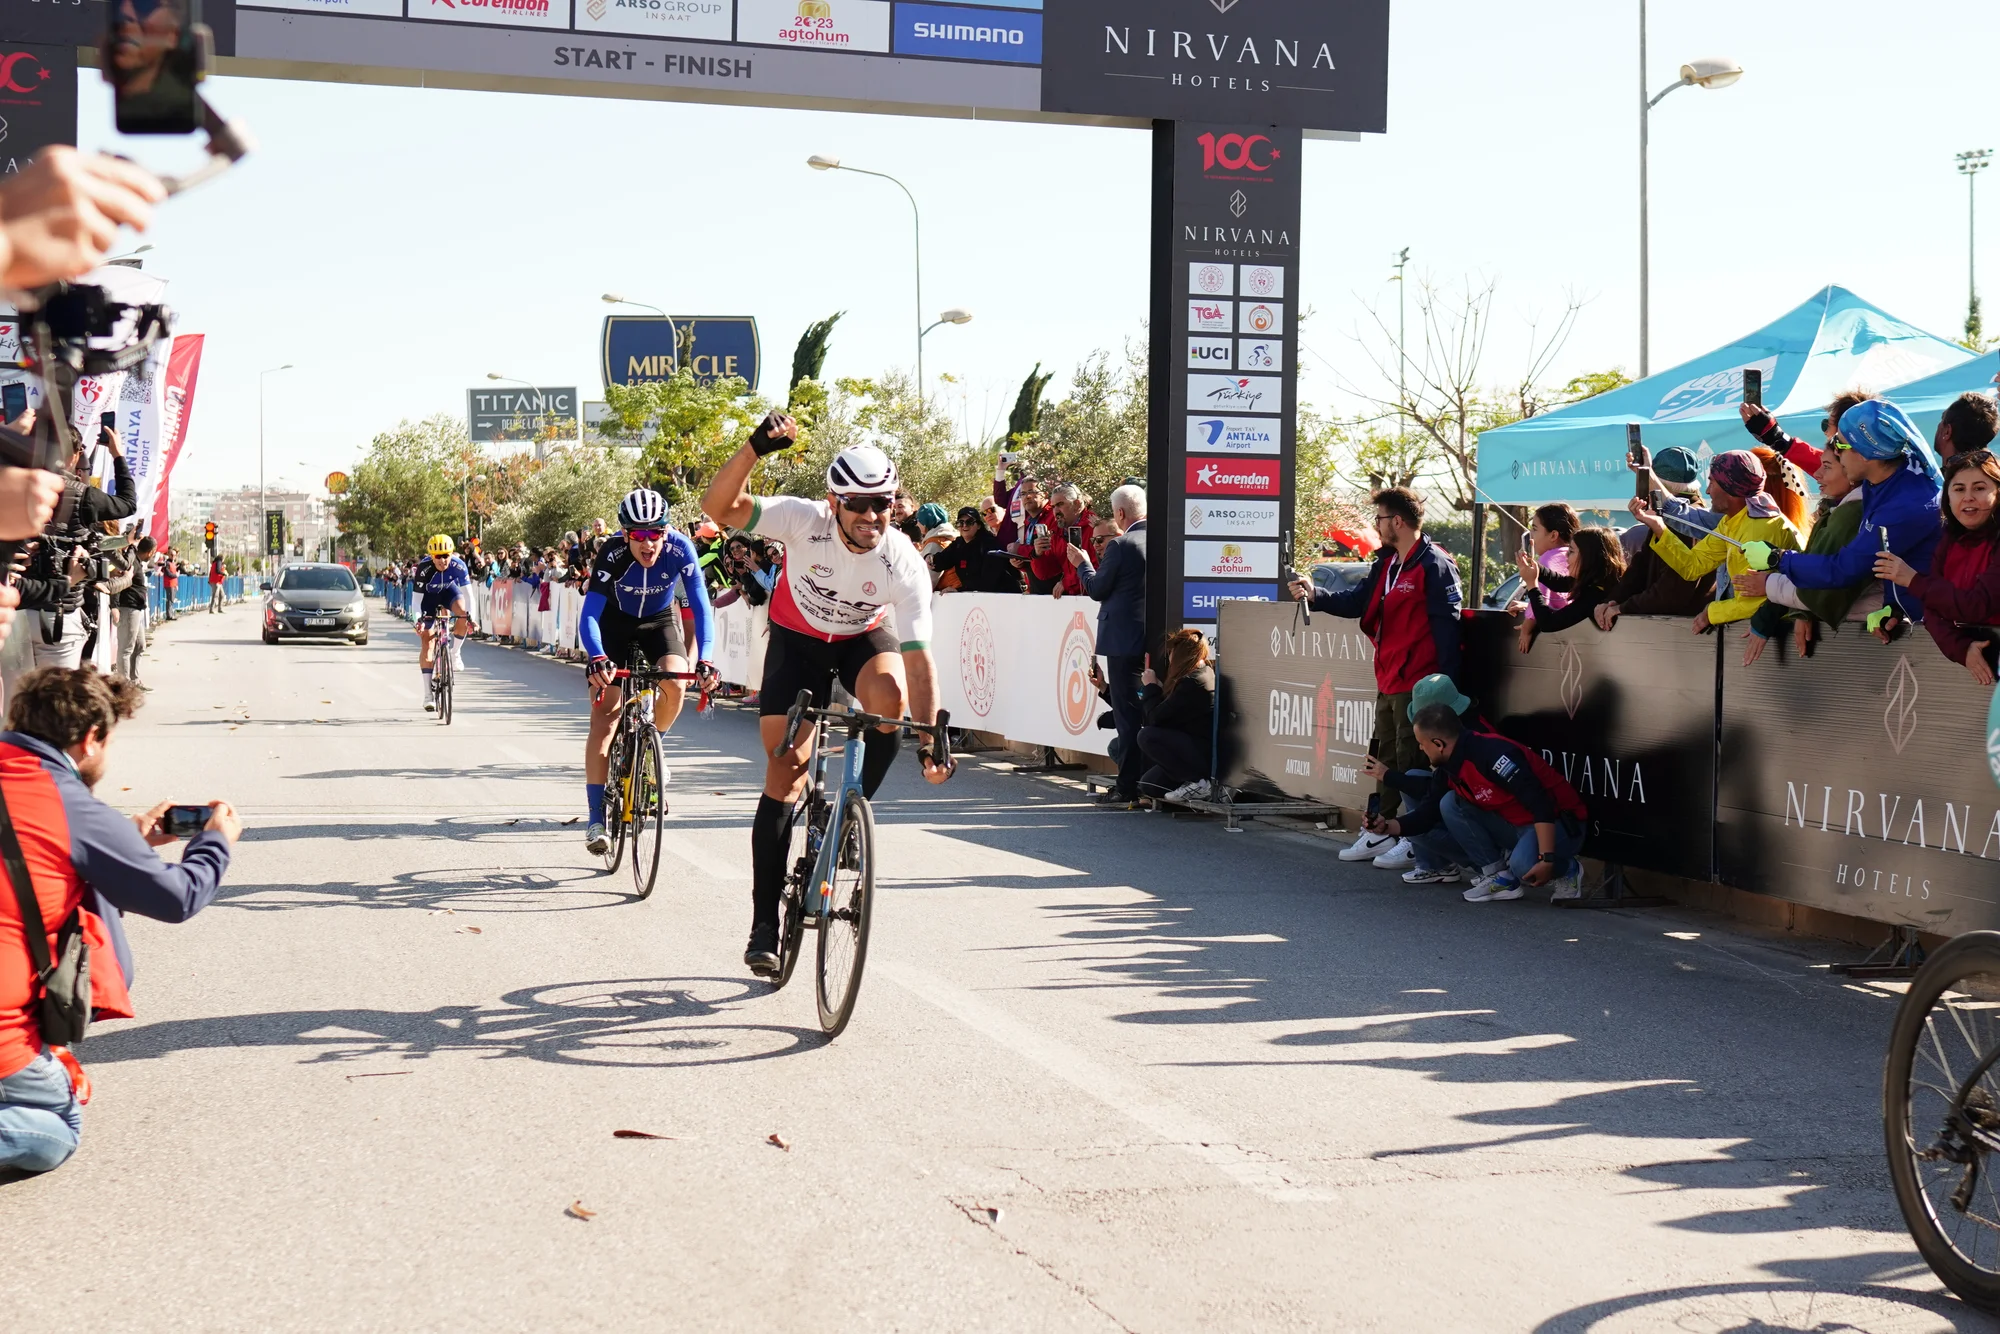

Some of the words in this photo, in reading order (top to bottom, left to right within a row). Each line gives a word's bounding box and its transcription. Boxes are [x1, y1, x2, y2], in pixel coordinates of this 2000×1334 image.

[501, 9, 548, 18] AIRLINES
[664, 0, 722, 15] GROUP
[778, 29, 849, 43] agtohum
[914, 22, 1024, 45] SHIMANO
[1105, 26, 1336, 70] NIRVANA
[553, 47, 637, 70] START
[664, 54, 752, 79] FINISH
[1171, 73, 1270, 92] HOTELS
[1184, 226, 1290, 245] NIRVANA
[1214, 249, 1260, 257] HOTELS
[1198, 346, 1229, 360] UCI
[628, 355, 738, 376] MIRCLE
[476, 394, 569, 412] TITANIC
[1207, 387, 1263, 411] Türkiye
[126, 409, 141, 477] ANTALYA
[1226, 432, 1270, 442] ANTALYA
[1226, 442, 1251, 450] Airport
[139, 440, 151, 478] Airport
[1522, 460, 1587, 477] NIRVANA
[1215, 472, 1270, 485] corendon
[1208, 510, 1237, 518] ARSO
[1238, 510, 1275, 519] GROUP
[1211, 564, 1252, 574] agtohum
[1285, 630, 1376, 662] NIRVAN
[1268, 689, 1313, 737] GRAN
[852, 746, 860, 777] FOCUS
[1495, 756, 1508, 770] UCI
[1285, 758, 1310, 776] ANTALYA
[1331, 762, 1358, 785] TÜRKİYE
[1785, 781, 2000, 860] NIRVANA
[1836, 863, 1932, 900] HOTELS
